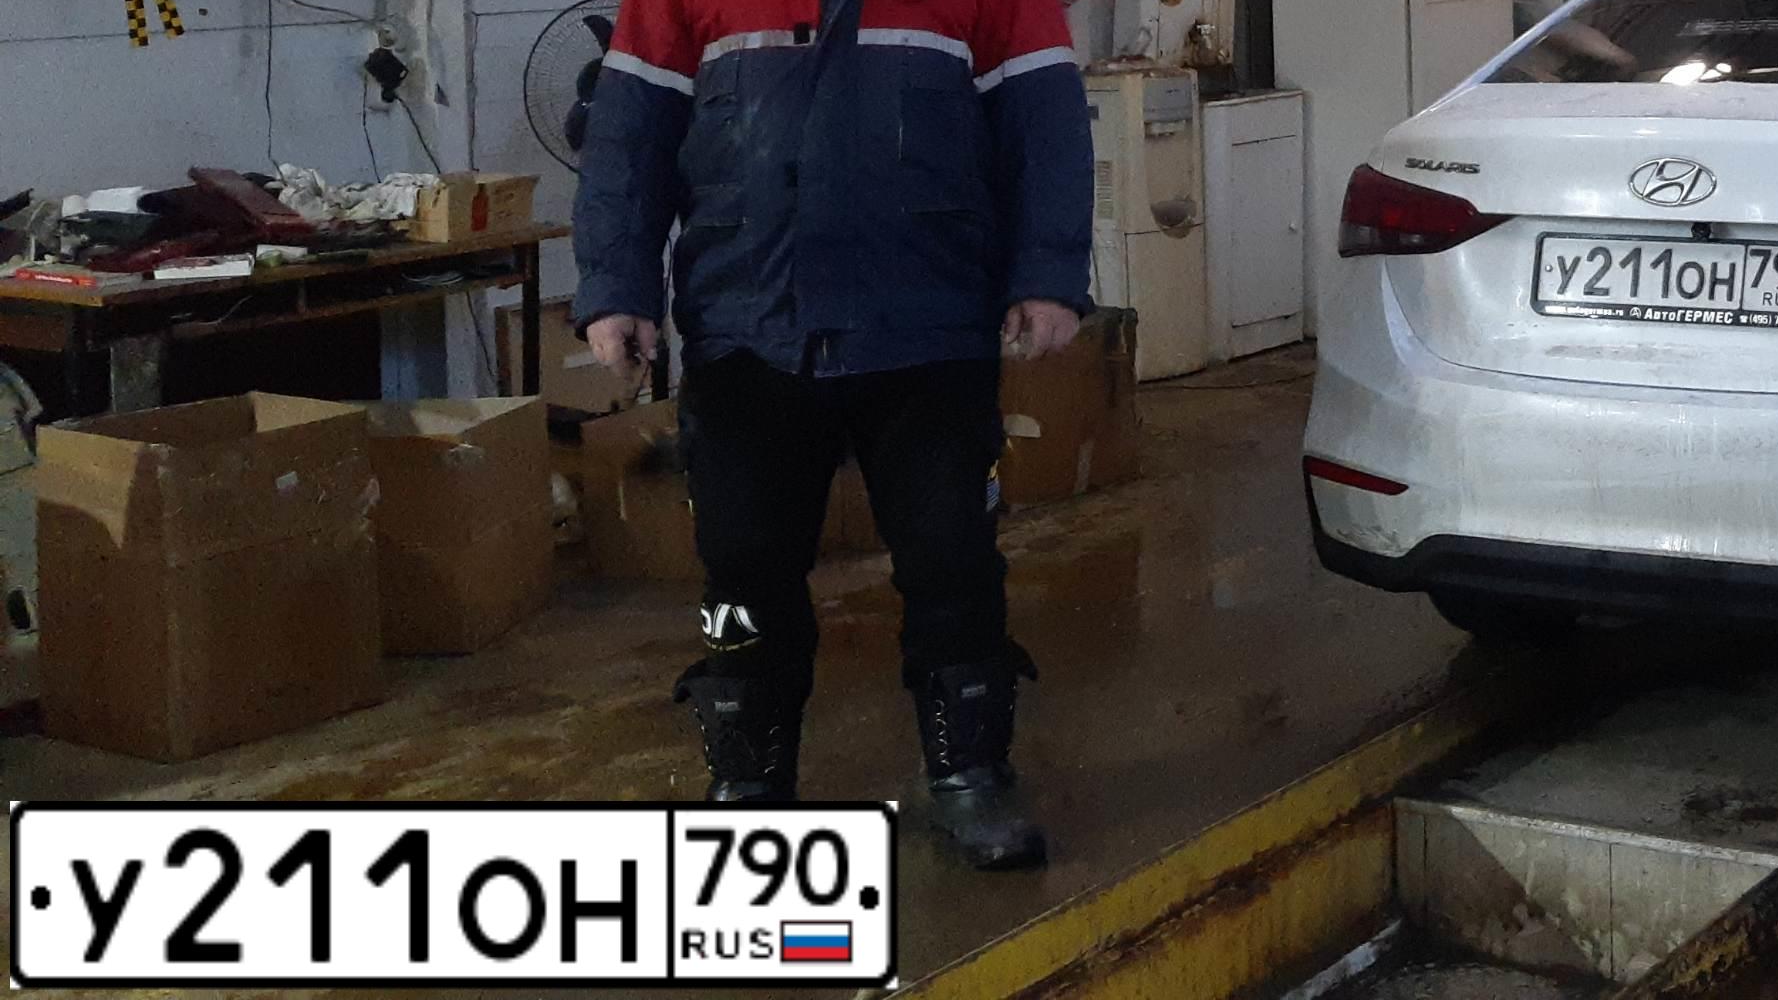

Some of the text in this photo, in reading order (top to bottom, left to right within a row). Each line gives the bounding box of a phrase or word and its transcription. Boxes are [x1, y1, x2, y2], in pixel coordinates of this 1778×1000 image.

[1404, 158, 1480, 174] SOLARIS
[1556, 246, 1737, 302] У211ОН
[1749, 313, 1772, 326] (495)
